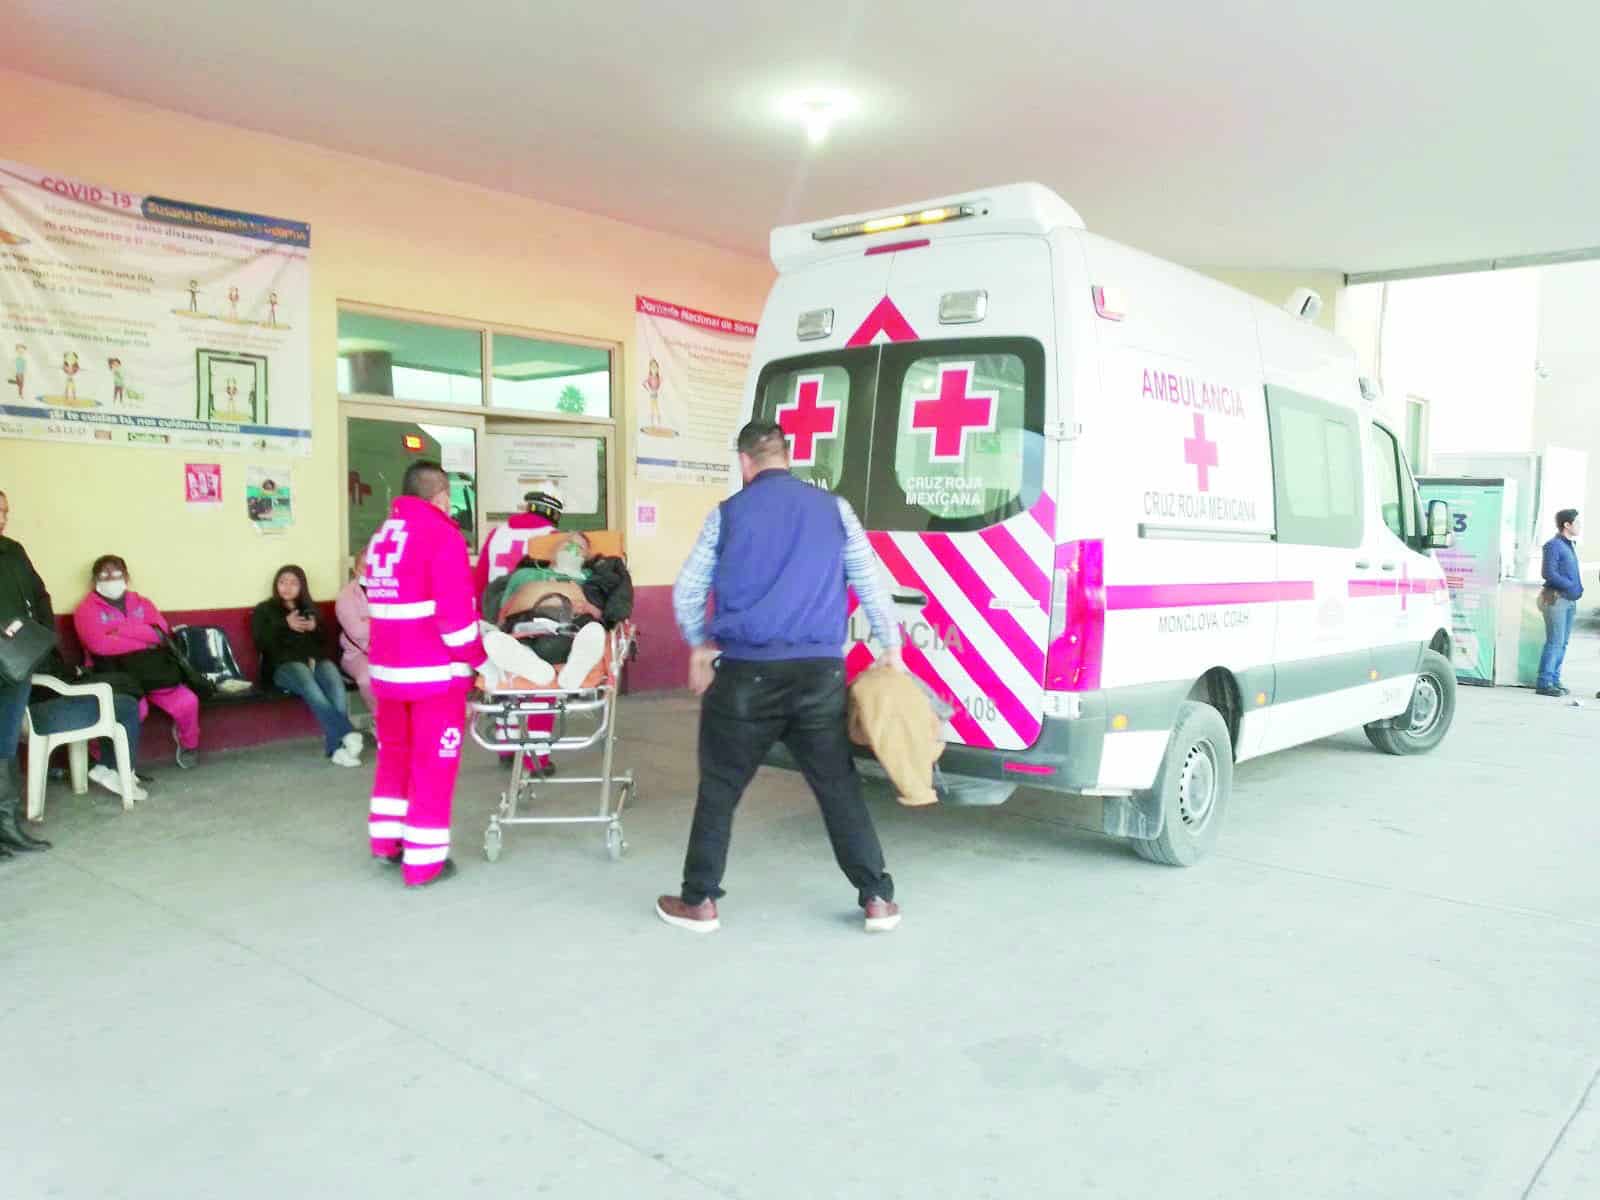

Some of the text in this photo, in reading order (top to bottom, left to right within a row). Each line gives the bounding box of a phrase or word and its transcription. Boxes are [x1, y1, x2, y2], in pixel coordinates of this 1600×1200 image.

[41, 177, 132, 207] COVID-19
[1142, 368, 1246, 419] AMBULANCIA
[907, 476, 983, 489] CRUZ ROJA
[906, 492, 981, 505] MEXICANA
[1143, 490, 1257, 521] CRUZ ROJA MEXICANA
[1158, 608, 1220, 633] MONCLOVA
